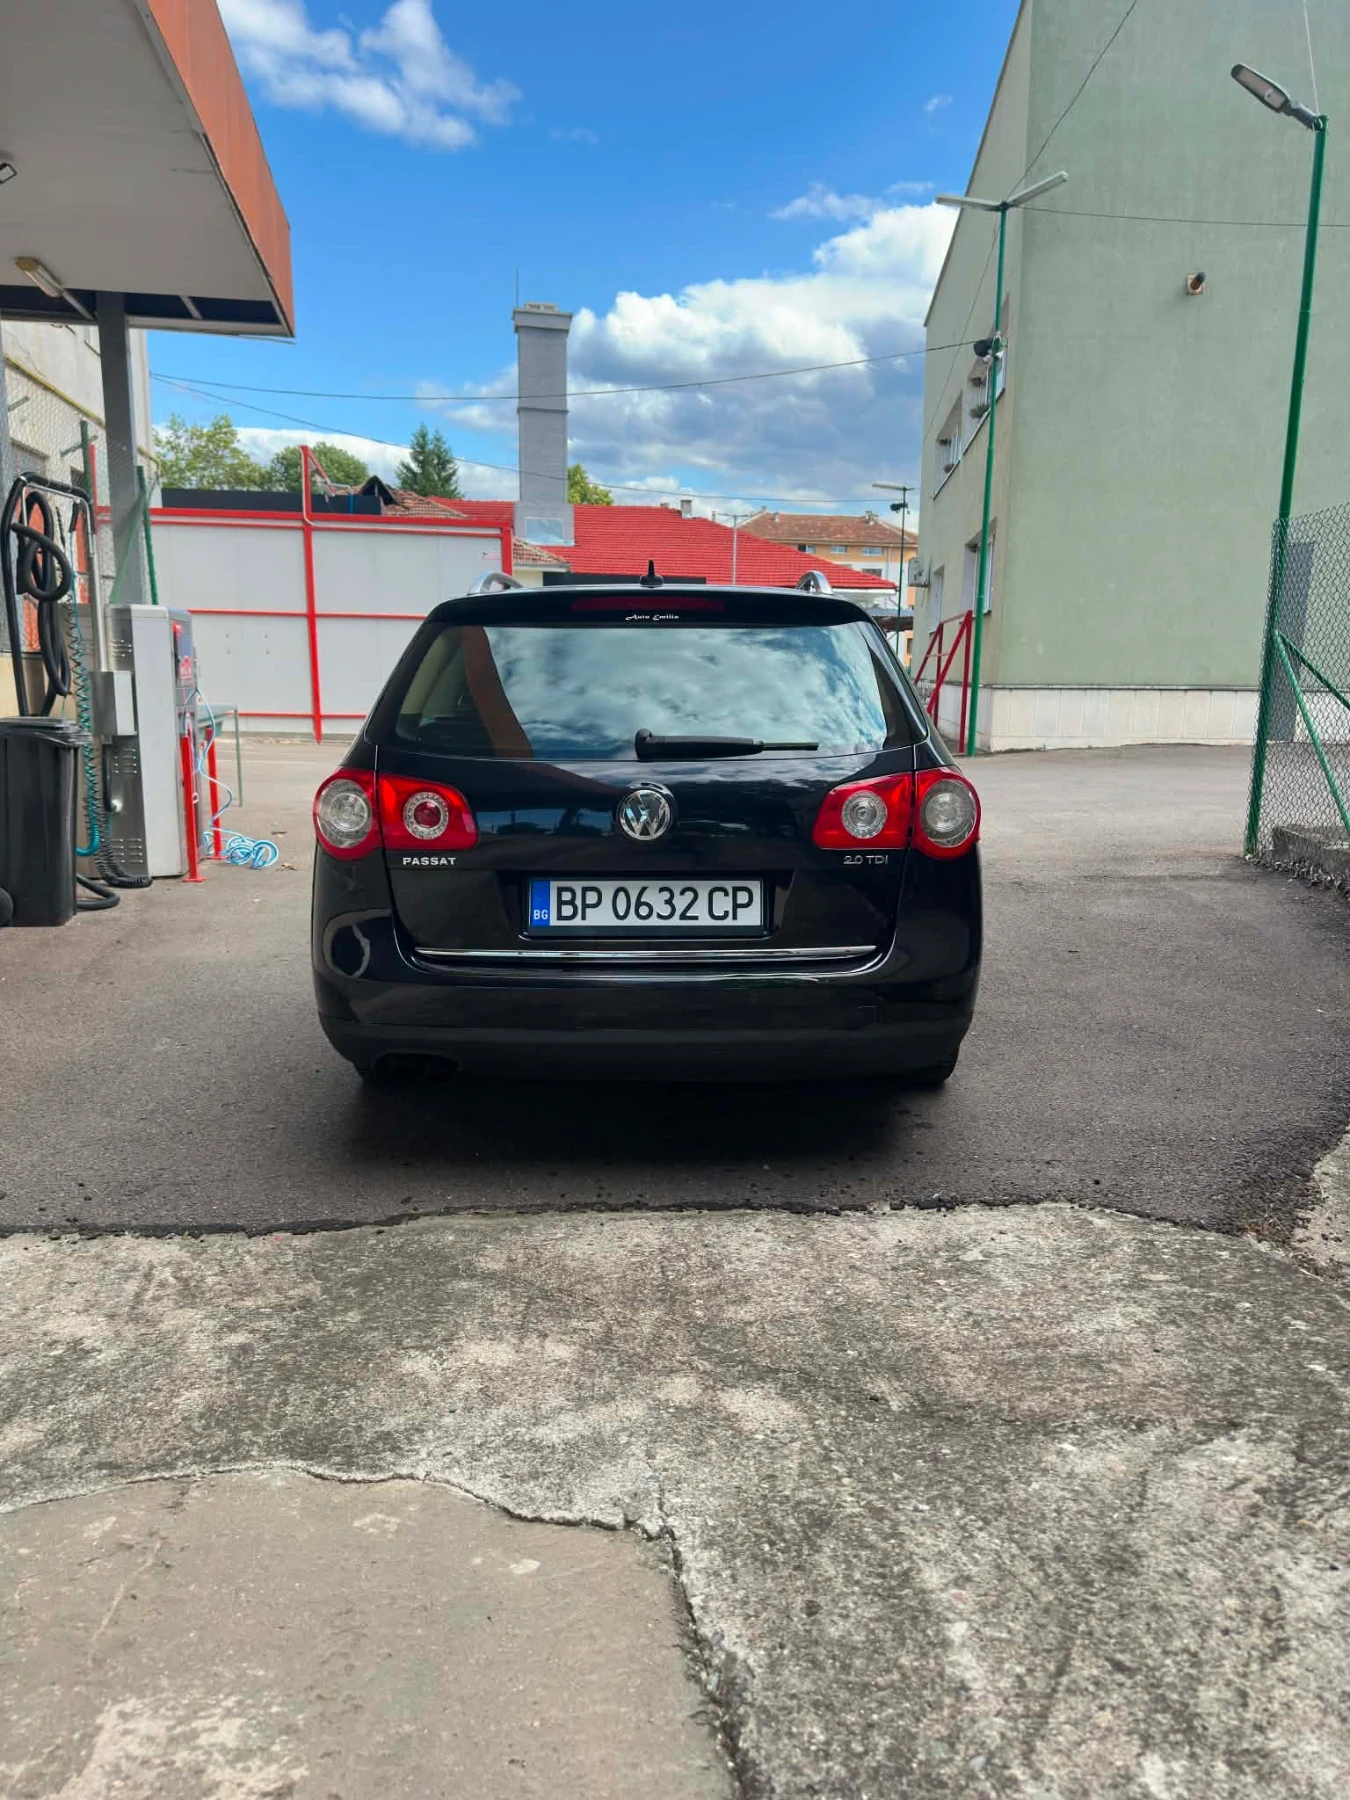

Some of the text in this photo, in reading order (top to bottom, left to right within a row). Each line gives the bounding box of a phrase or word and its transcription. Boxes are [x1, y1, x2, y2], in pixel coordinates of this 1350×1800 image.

[402, 856, 456, 866] PASSAT
[865, 855, 889, 865] TDI
[556, 886, 754, 921] BP 0632 CP
[533, 909, 549, 920] BG
